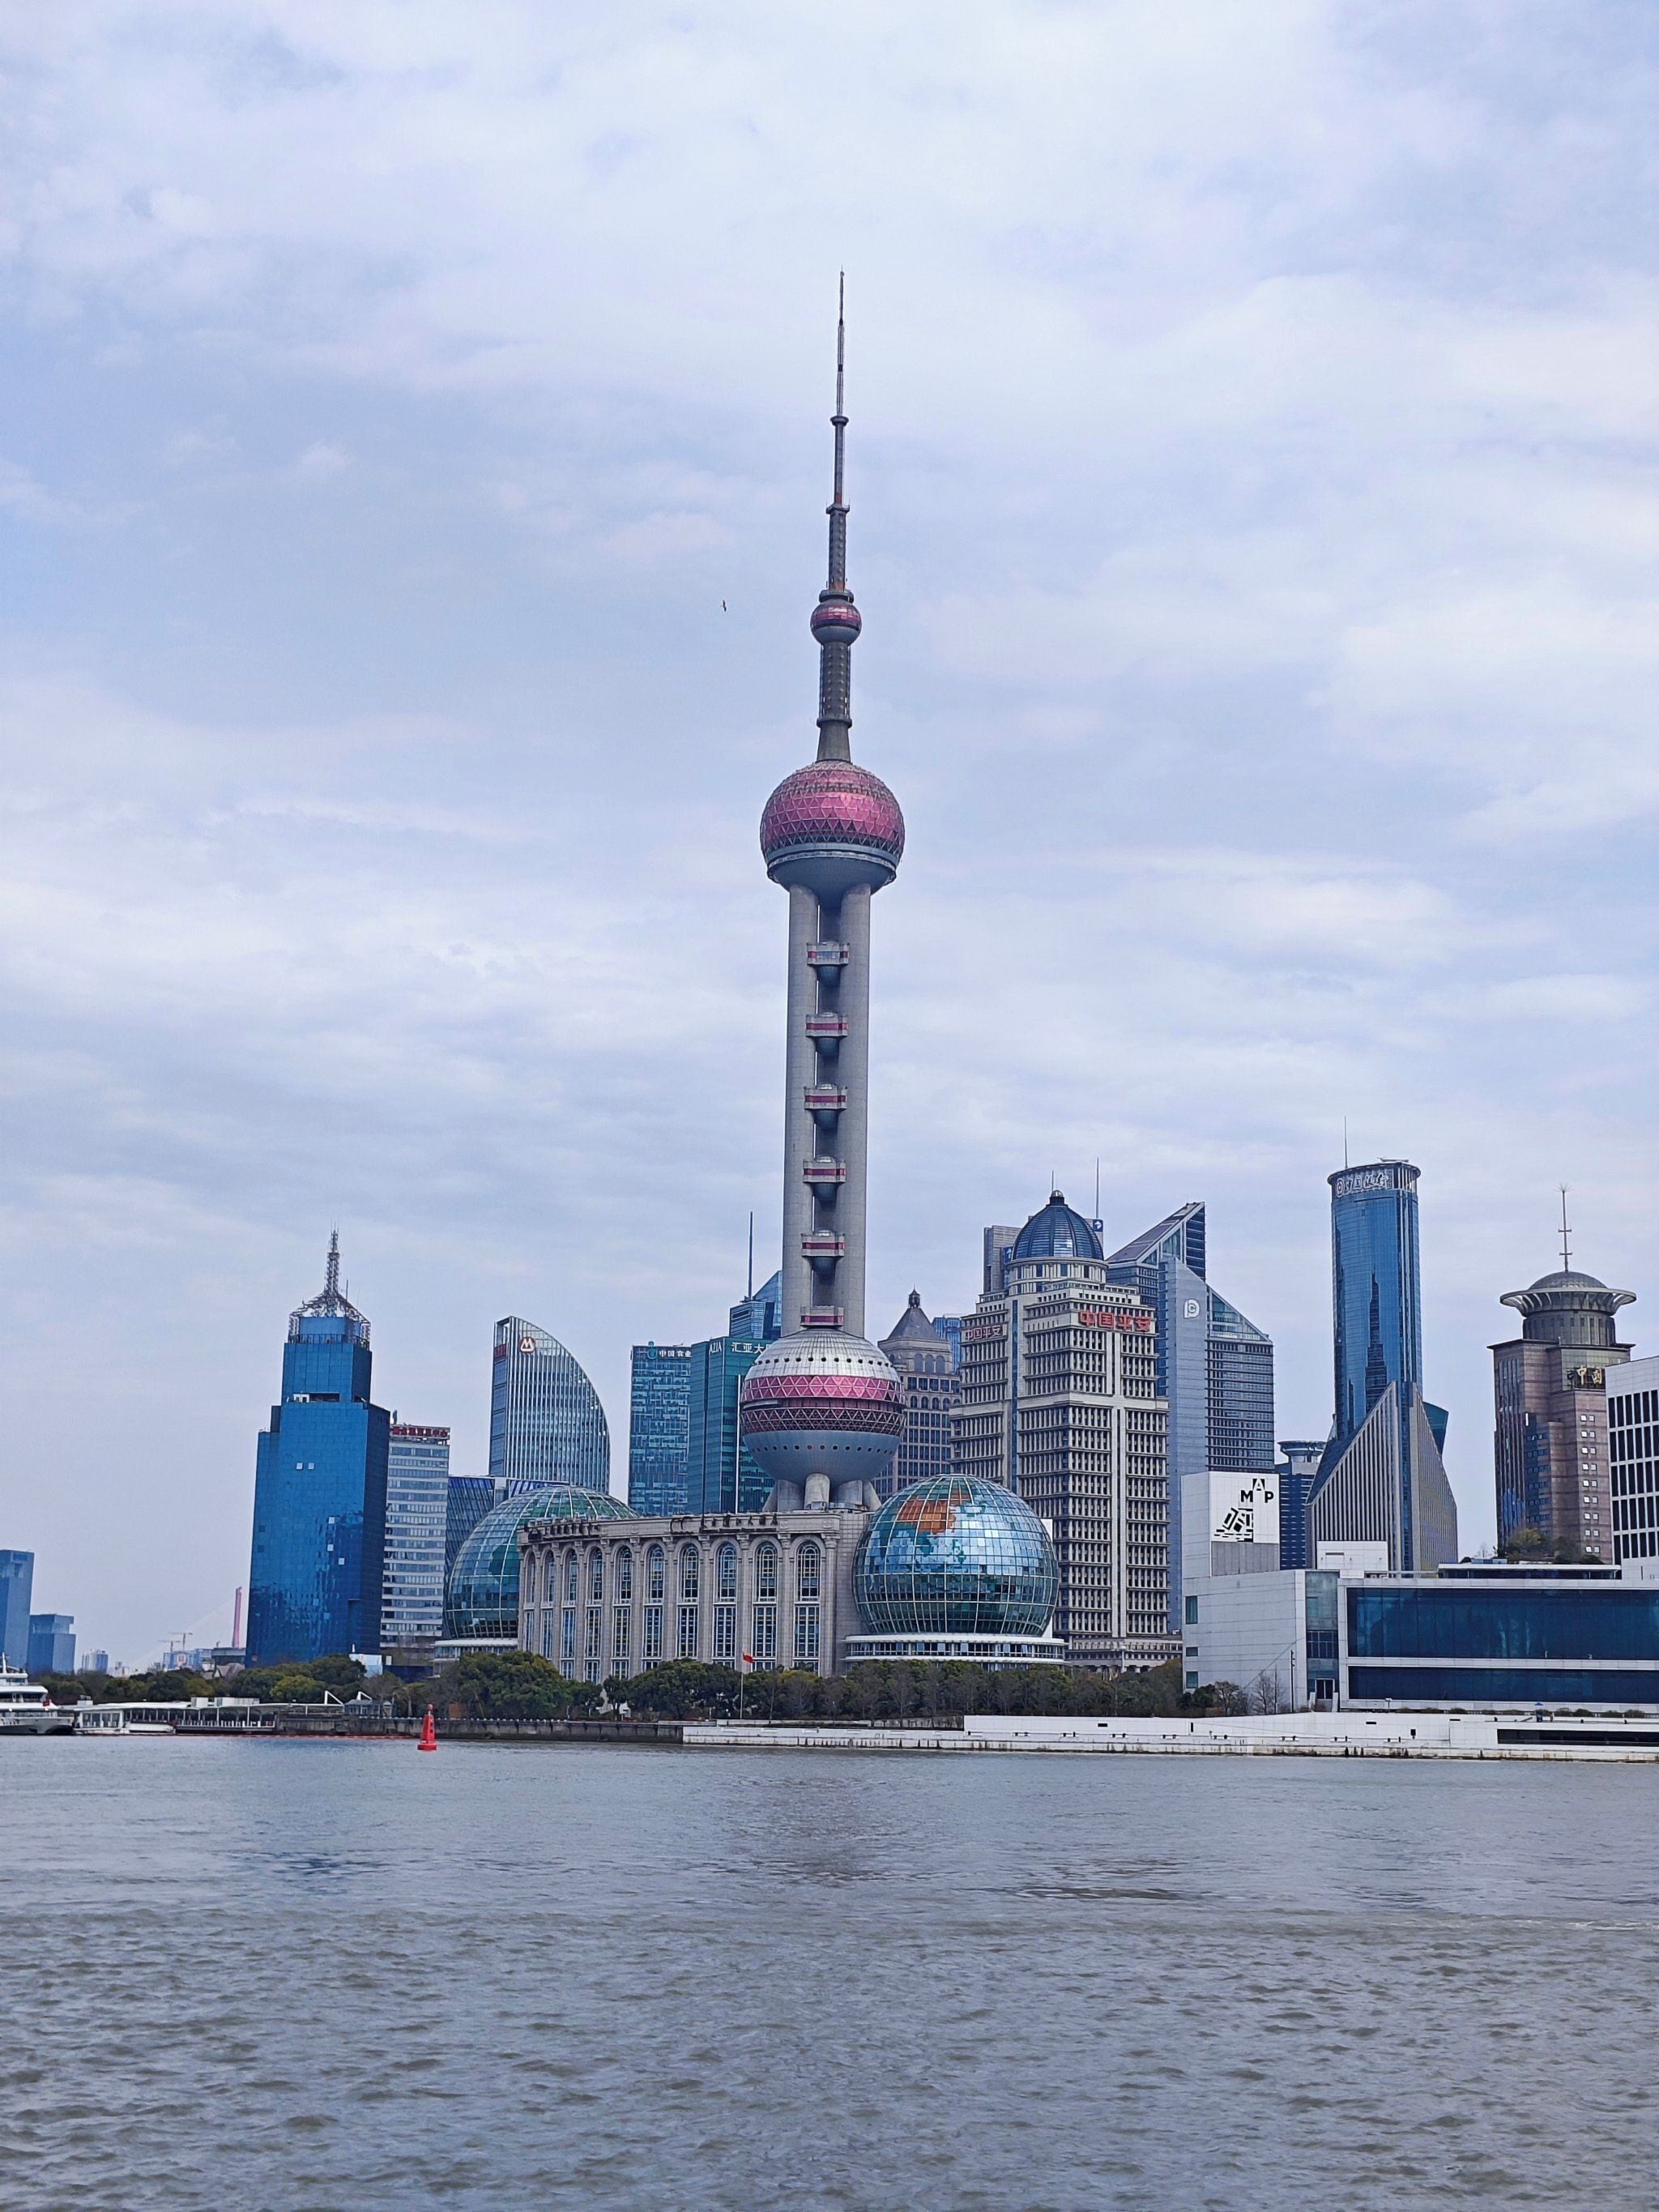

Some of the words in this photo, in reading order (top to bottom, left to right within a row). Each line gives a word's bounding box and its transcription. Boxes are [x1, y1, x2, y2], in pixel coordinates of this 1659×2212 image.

[1079, 1309, 1151, 1333] 中国平安
[964, 1325, 1002, 1342] 中国平安
